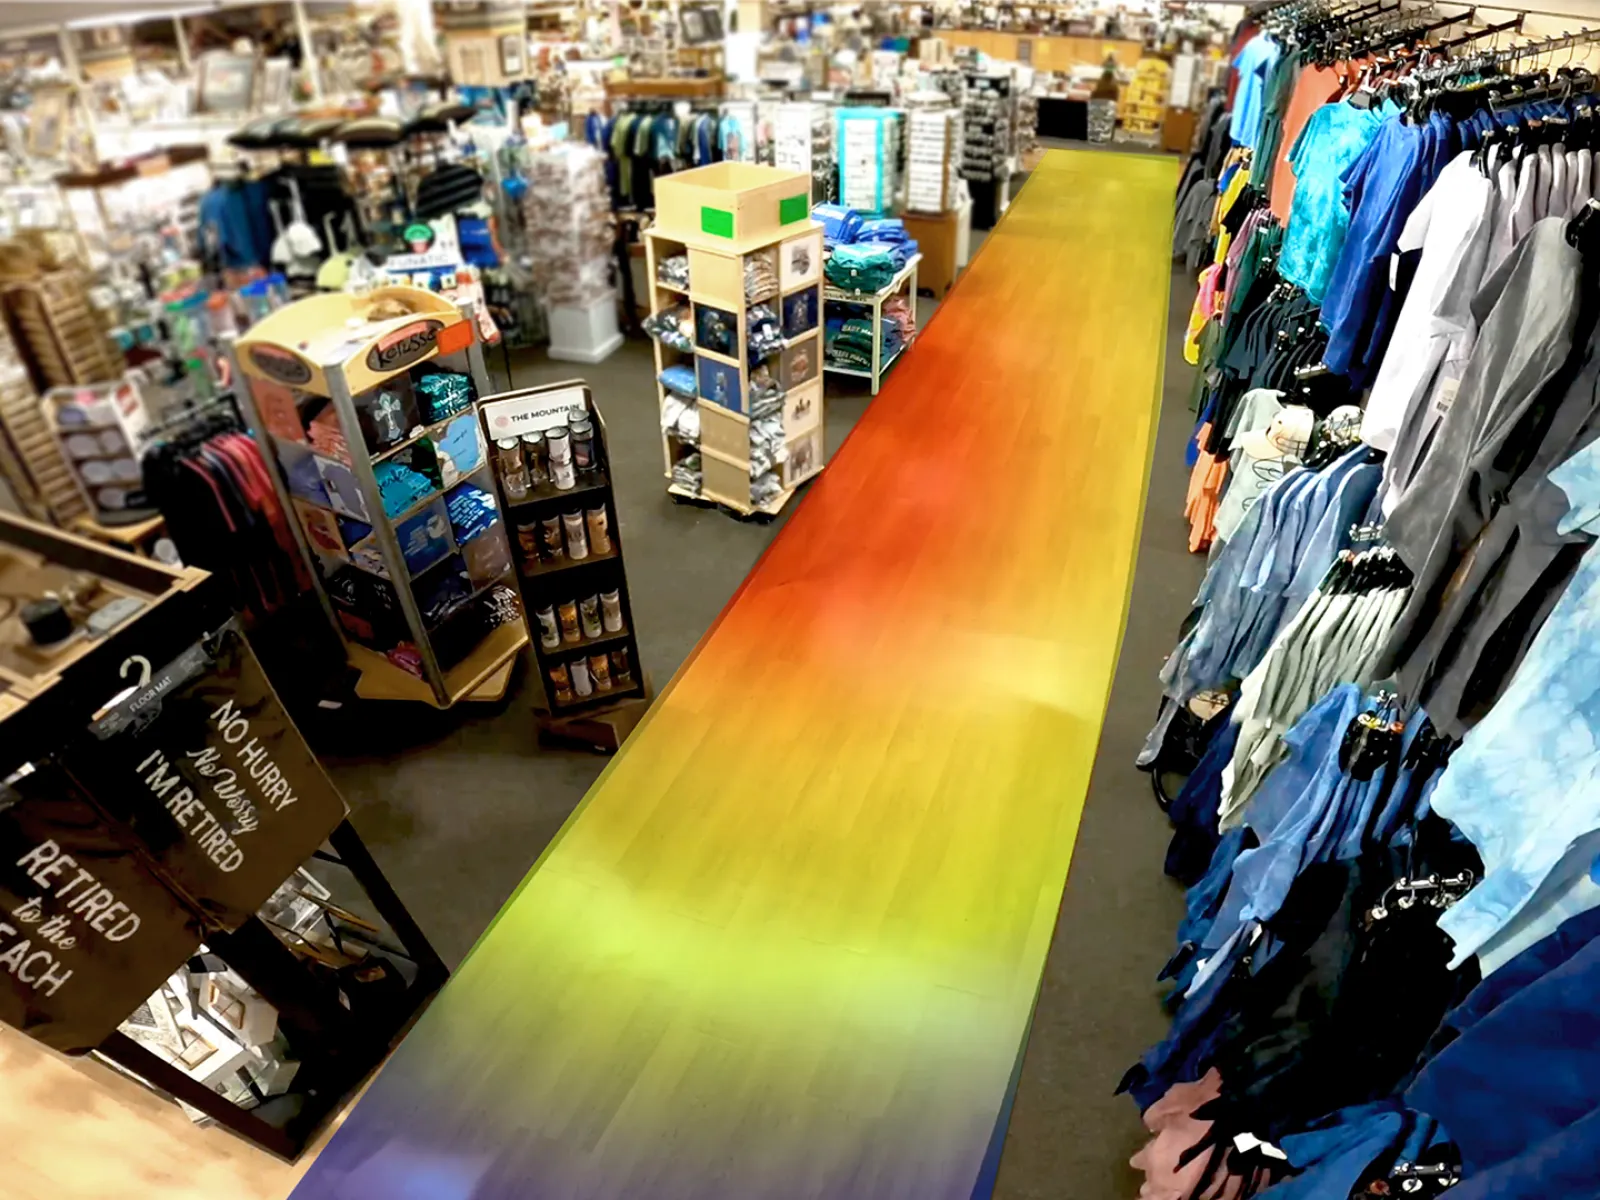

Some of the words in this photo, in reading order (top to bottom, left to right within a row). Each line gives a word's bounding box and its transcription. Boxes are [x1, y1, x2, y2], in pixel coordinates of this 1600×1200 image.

[511, 412, 530, 422] THE
[531, 404, 580, 419] MOUNTAIN
[129, 689, 157, 713] FLOOR
[154, 675, 173, 693] MAT
[186, 746, 221, 778] No
[212, 768, 259, 836] Worry
[210, 699, 250, 744] NO
[236, 737, 298, 812] HURRY
[135, 749, 181, 799] I'M
[164, 786, 244, 873] RETIRED
[11, 896, 43, 923] to
[36, 914, 77, 950] the
[15, 838, 141, 942] RETIRED
